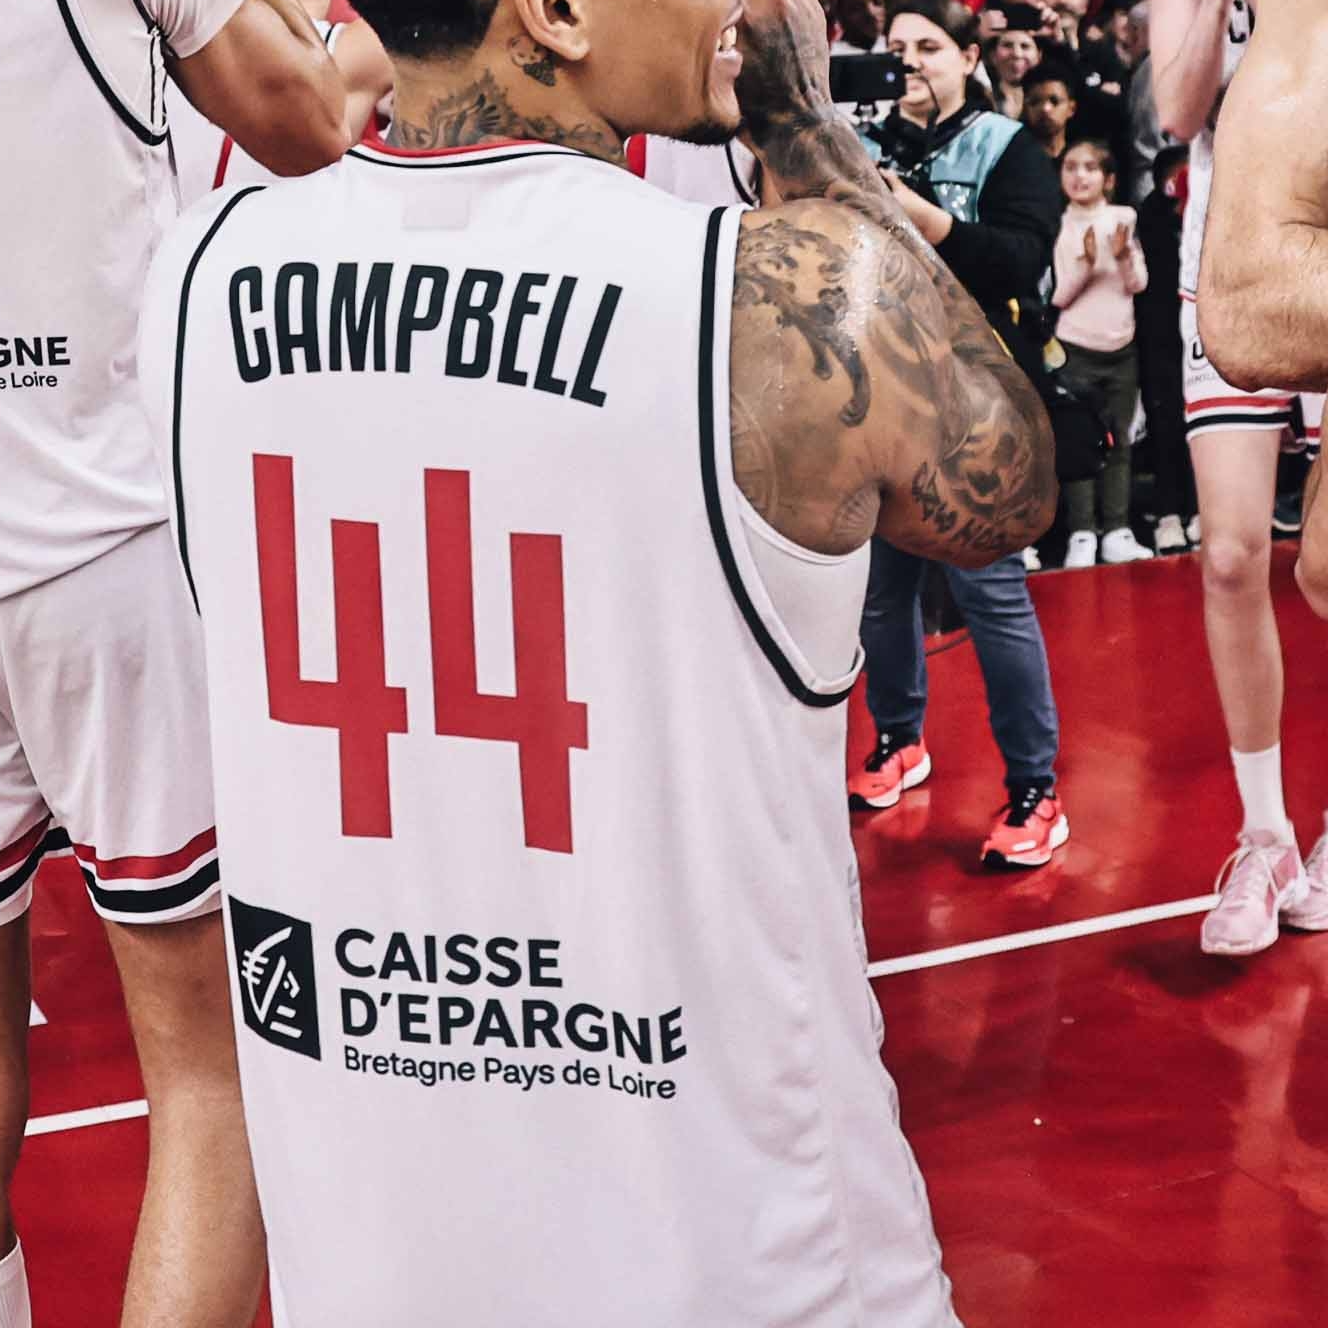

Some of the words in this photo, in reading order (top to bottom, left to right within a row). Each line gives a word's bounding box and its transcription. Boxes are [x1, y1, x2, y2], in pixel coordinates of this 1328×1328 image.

[228, 262, 623, 408] CAMPBELL
[11, 371, 58, 389] Loire
[252, 453, 589, 855] 44
[334, 928, 564, 989] CAISSE
[340, 987, 688, 1066] D'EPARGNE
[344, 1045, 476, 1087] Bretagne
[484, 1057, 555, 1092] Pays
[562, 1060, 601, 1086] de
[608, 1064, 677, 1099] Loire
